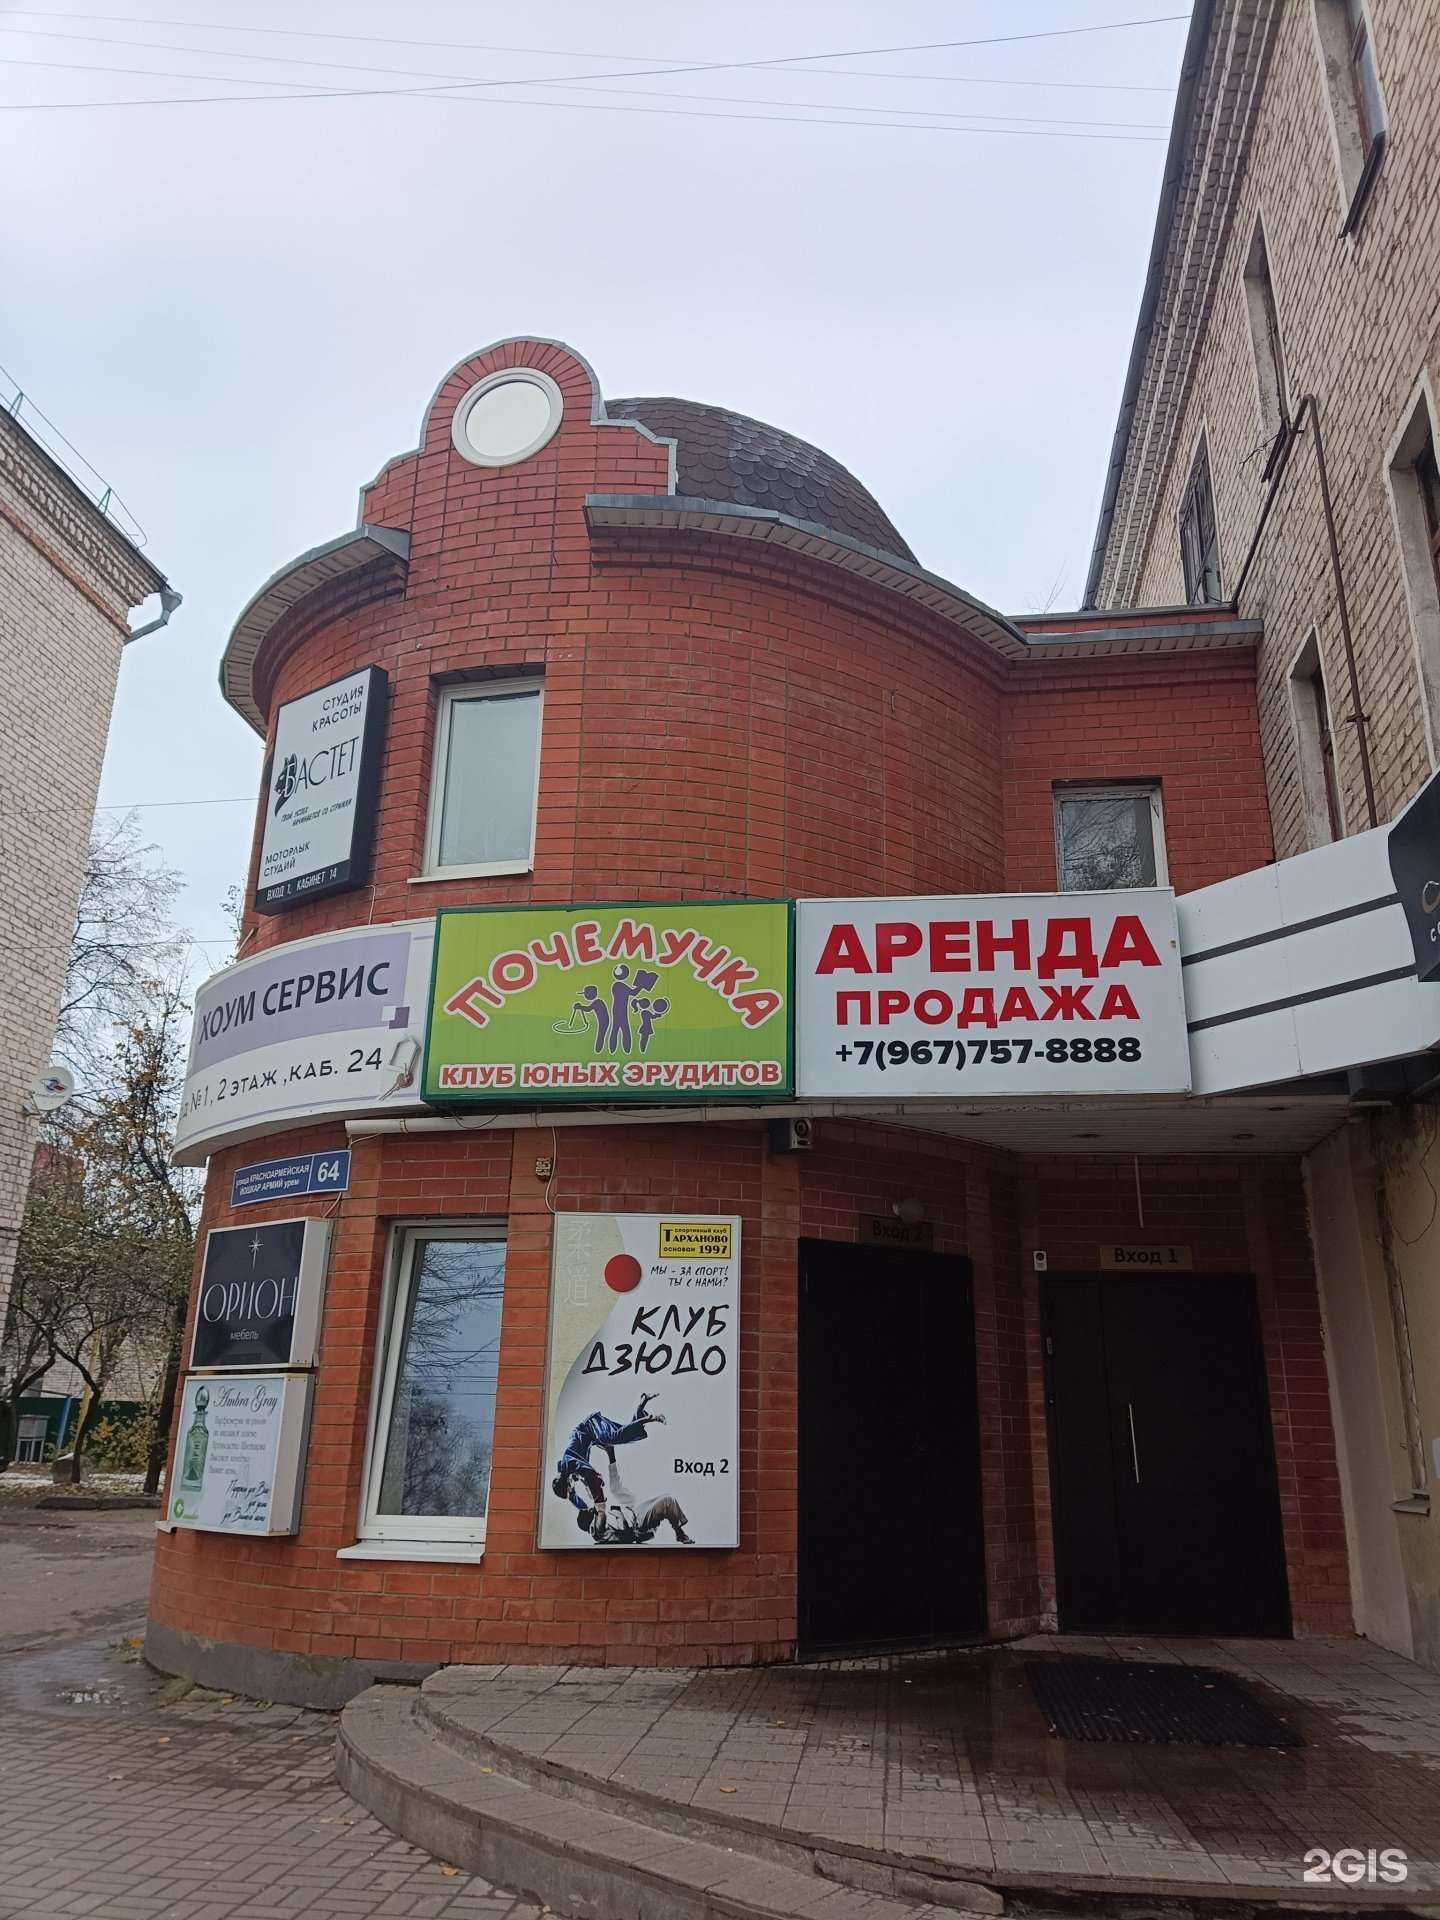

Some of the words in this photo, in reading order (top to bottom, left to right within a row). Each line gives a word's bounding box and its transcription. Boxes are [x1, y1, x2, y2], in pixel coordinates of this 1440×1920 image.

[322, 685, 364, 711] СТУДИЯ
[311, 702, 362, 732] КРАСОТЫ
[283, 736, 359, 798] БАСТЕТ
[265, 841, 311, 865] МОТОРЛЫК
[263, 857, 296, 877] СТУДИЙ
[266, 885, 285, 901] ВХОД
[296, 871, 326, 892] КАБИНЕТ
[815, 915, 1162, 979] АРЕНДА
[445, 919, 782, 1028] ПОЧЕМУЧКА
[198, 991, 256, 1044] ХОУМ
[262, 962, 390, 1016] СЕРВИС
[836, 984, 1140, 1029] ПРОДАЖА
[835, 1037, 1142, 1071] +7(967)757-8888
[217, 1078, 227, 1101] 2
[347, 1047, 382, 1073] 24
[441, 1065, 514, 1086] КЛУБ
[523, 1064, 617, 1085] ЮНЫХ
[626, 1063, 781, 1088] ЭРУДИТОВ
[250, 1164, 310, 1182] КРАСНОАРМЕЙСКАЯ
[317, 1160, 340, 1183] 64
[663, 1228, 729, 1243] ТАРХАНОВО
[872, 1220, 911, 1241] Вход
[698, 1244, 728, 1255] 1997
[1113, 1247, 1162, 1265] Вход
[1168, 1248, 1179, 1264] 1
[650, 1265, 668, 1276] МЫ
[680, 1265, 692, 1276] ЗА
[695, 1265, 729, 1276] СПОРТ!
[668, 1277, 683, 1287] ТЫ
[695, 1276, 729, 1288] НАМИ?
[203, 1276, 299, 1322] ОРИОН
[230, 1328, 260, 1341] мебель
[631, 1304, 729, 1340] КЛУБ
[582, 1341, 727, 1376] ДЗЮДО
[673, 1458, 715, 1476] Вход
[719, 1458, 729, 1474] 2
